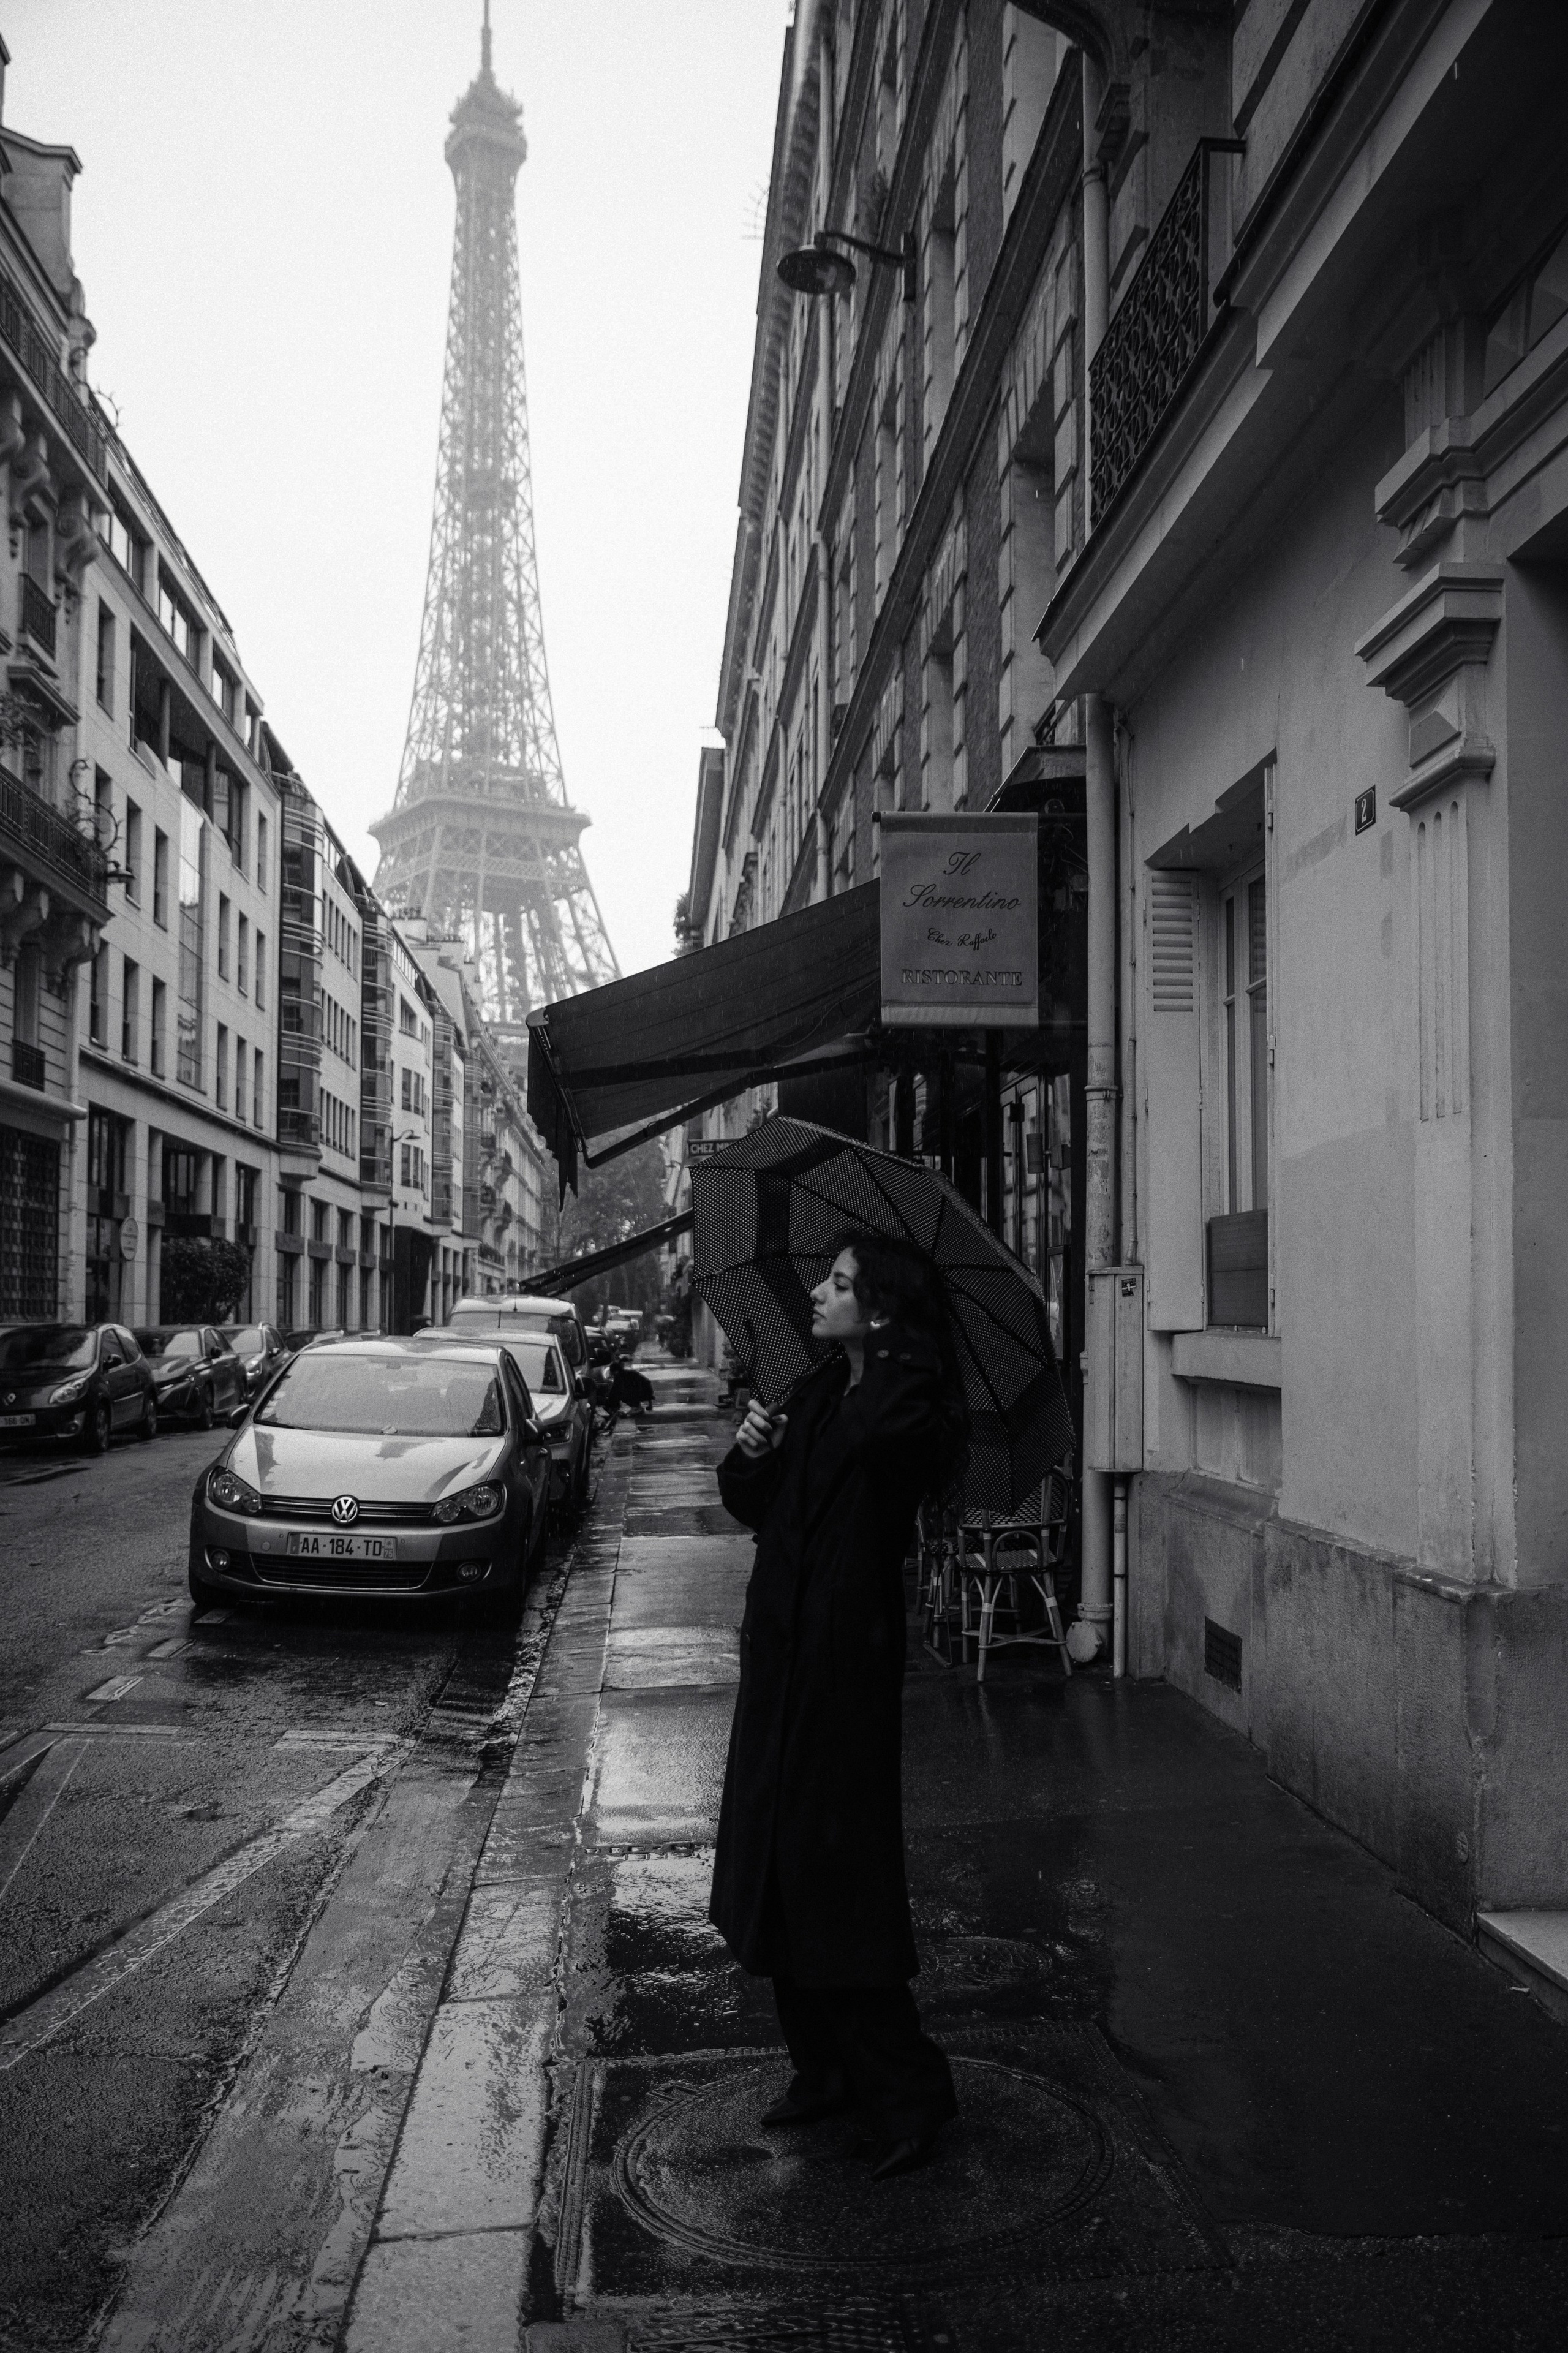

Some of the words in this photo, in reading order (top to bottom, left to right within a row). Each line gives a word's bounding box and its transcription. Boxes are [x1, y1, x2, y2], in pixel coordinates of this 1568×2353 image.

[1362, 798, 1367, 823] 2
[943, 852, 981, 875] Il
[903, 884, 1022, 910] Sorrentino
[927, 928, 952, 946] Chez
[957, 929, 997, 951] Raffaele
[902, 969, 1022, 986] RISTORANTE
[690, 1143, 715, 1154] CHEZ
[384, 1549, 393, 1558] 75
